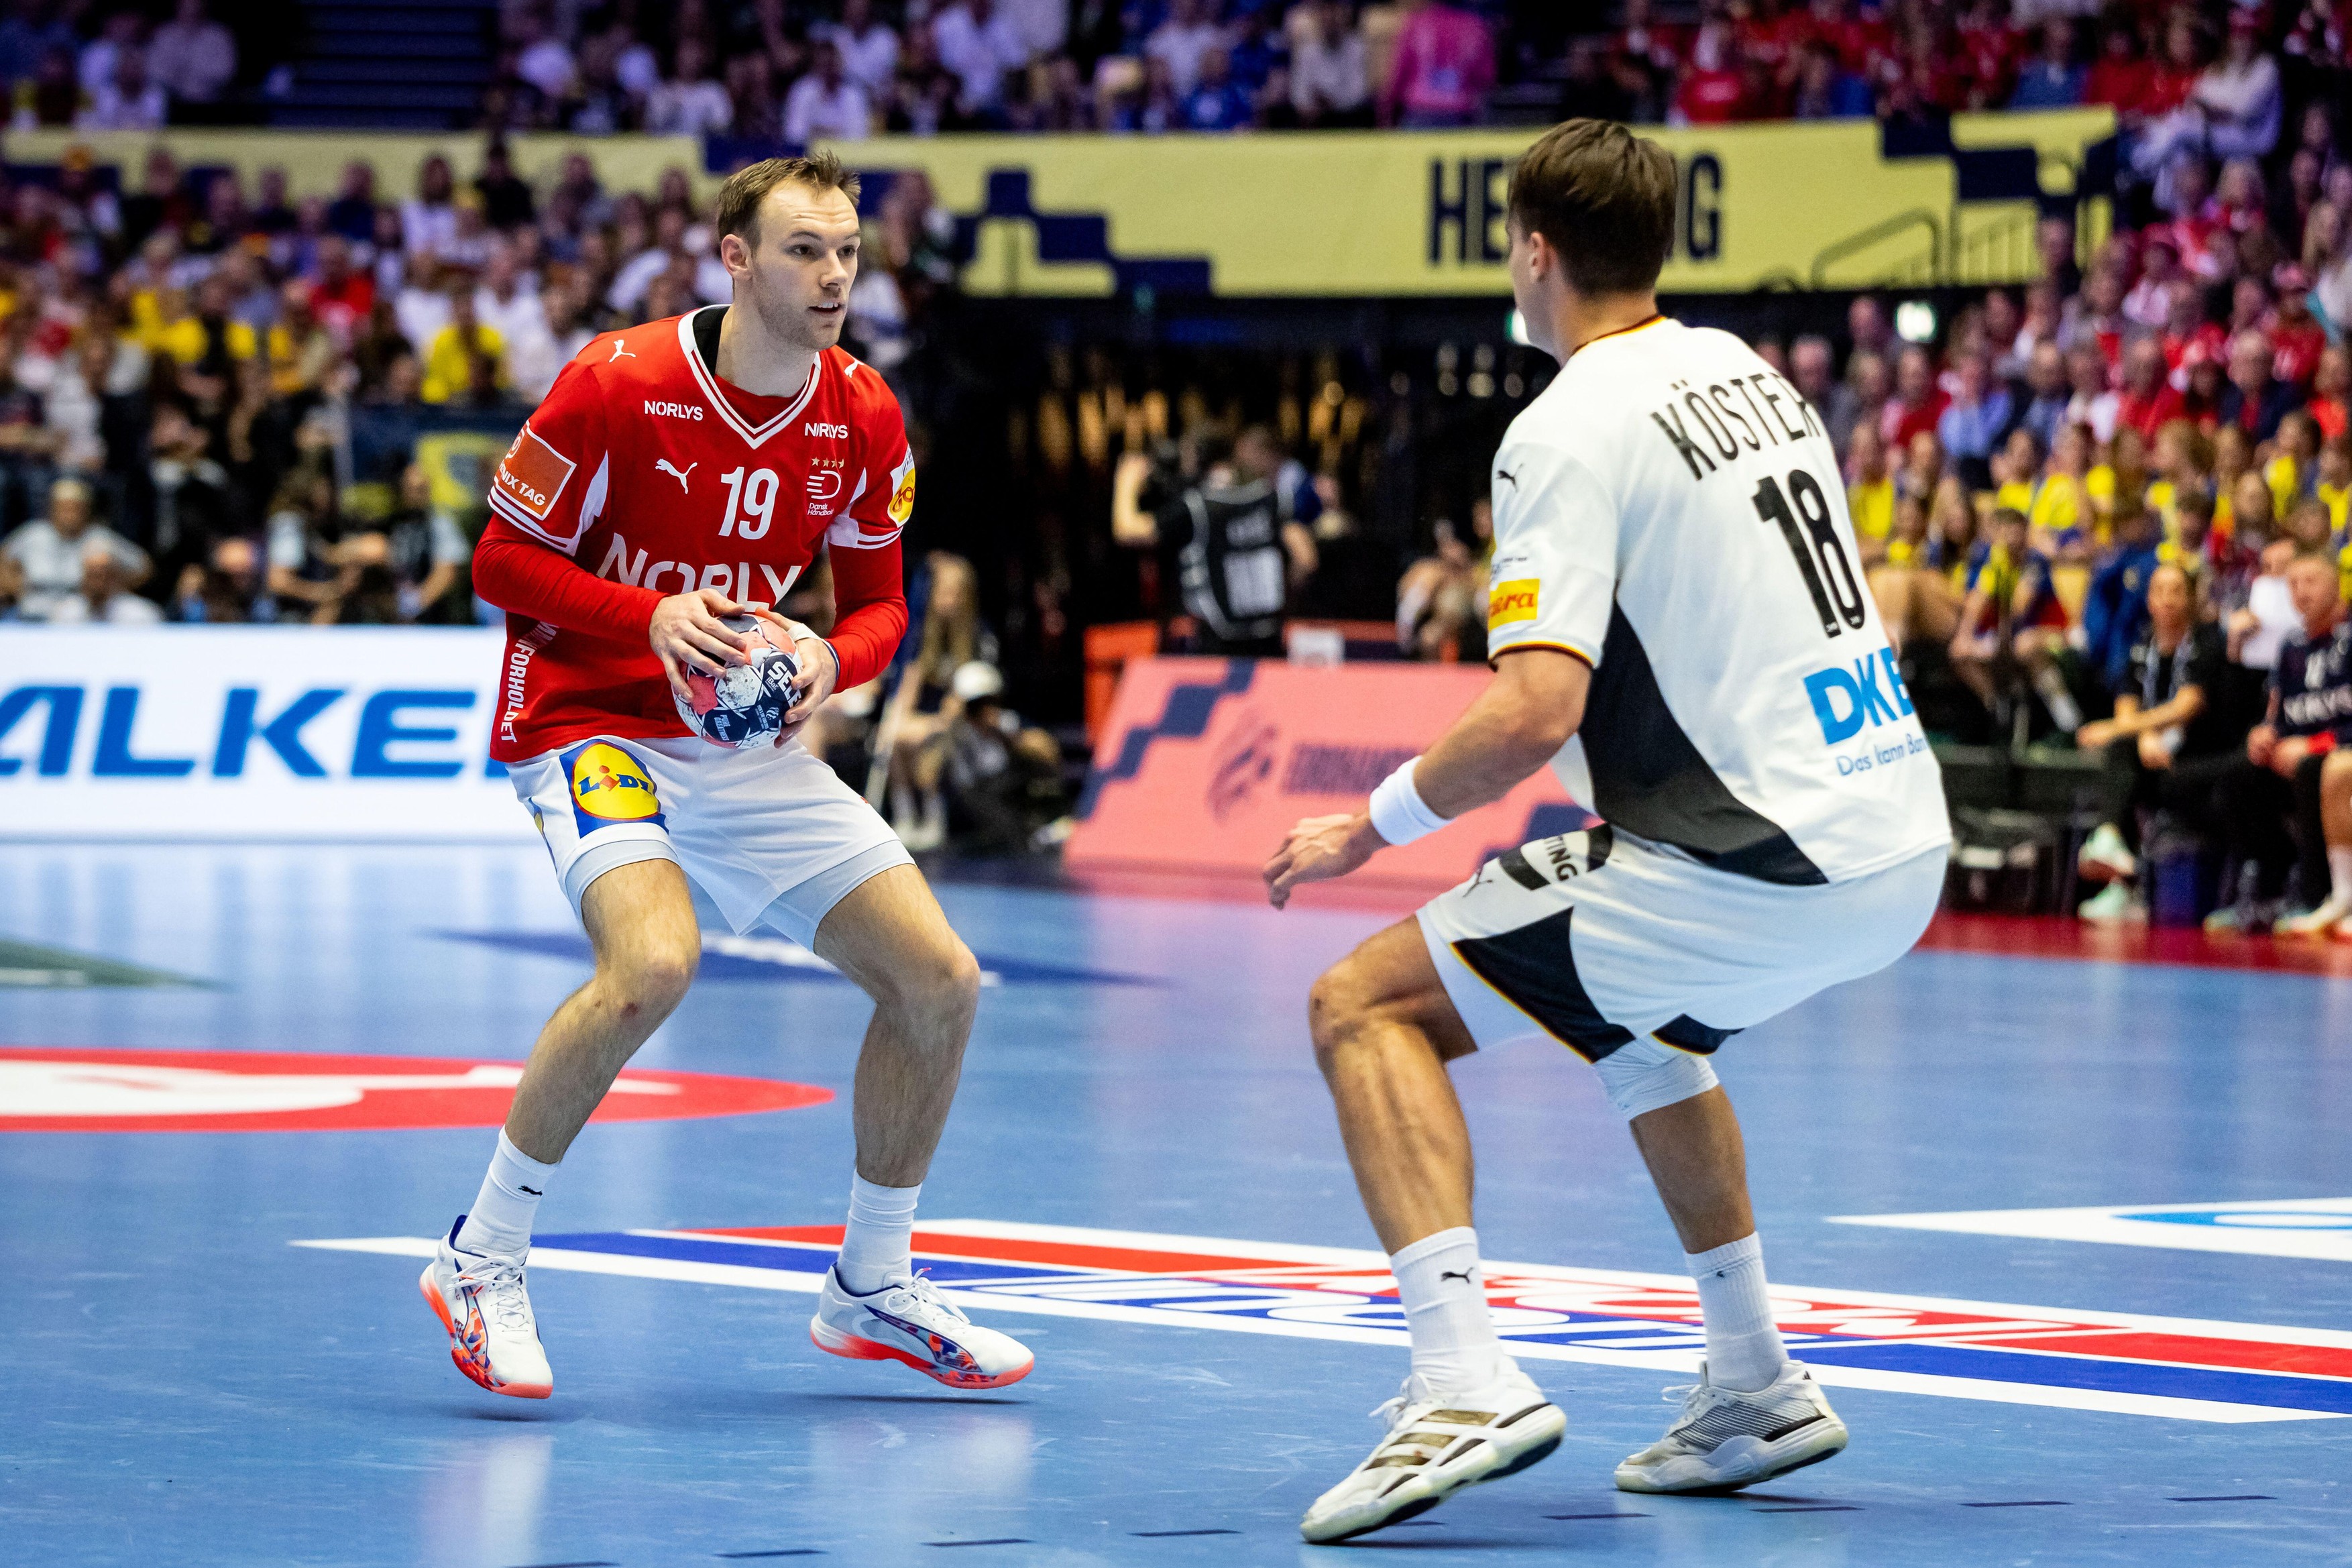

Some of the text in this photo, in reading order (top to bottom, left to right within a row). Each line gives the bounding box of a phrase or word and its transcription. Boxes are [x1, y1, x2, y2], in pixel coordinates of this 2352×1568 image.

[645, 400, 704, 421] NORLYS
[1650, 371, 1822, 482] KÖSTER
[499, 461, 546, 506] NIX TAG
[718, 466, 780, 541] 19
[809, 502, 828, 510] Dansk
[1750, 469, 1865, 639] 18
[767, 661, 803, 708] SELE
[1802, 646, 1915, 746] DKB
[0, 686, 508, 777] ALKE
[1836, 755, 1873, 777] Das
[1874, 743, 1905, 766] kann
